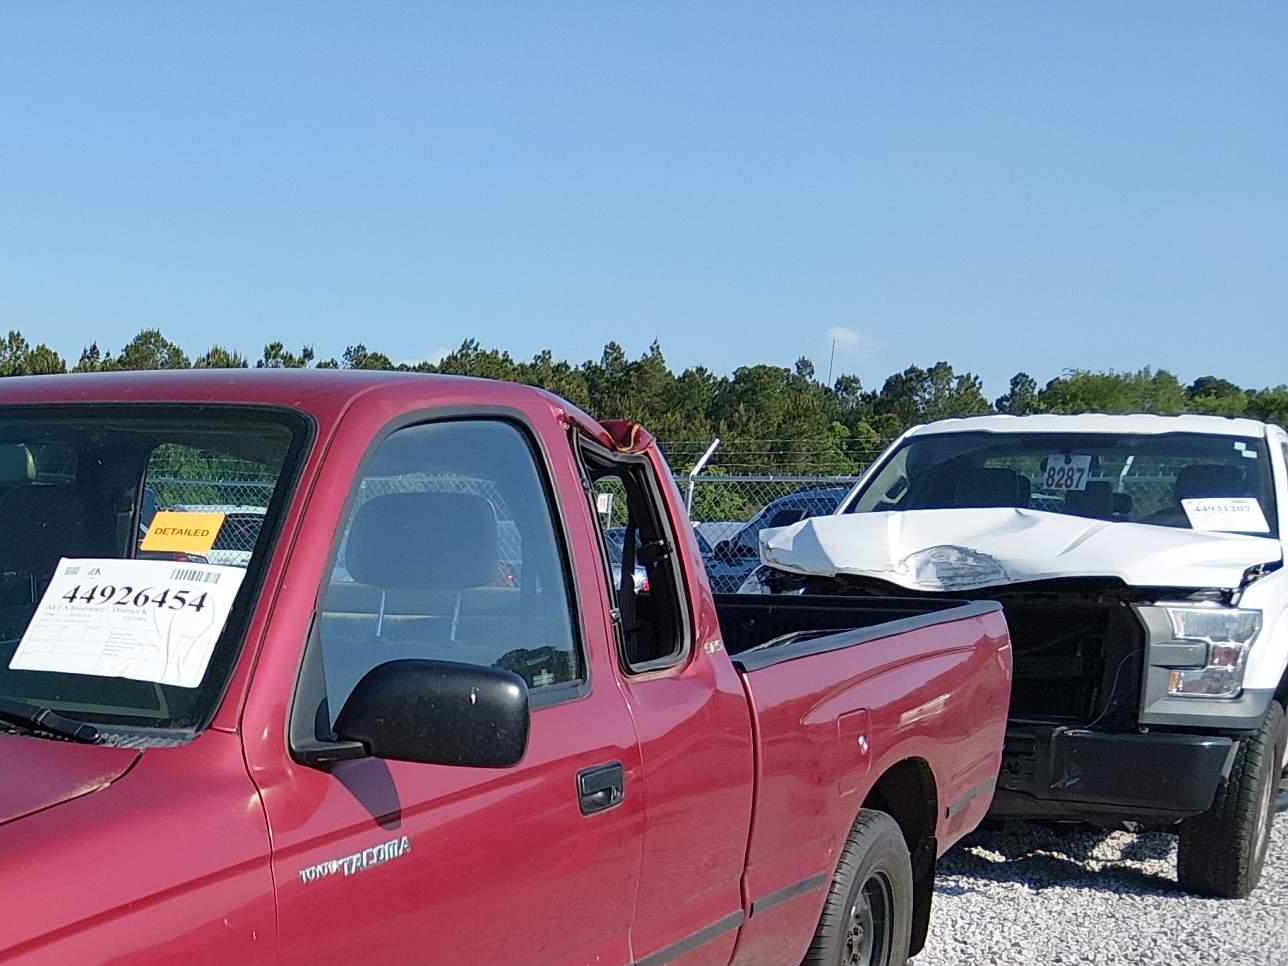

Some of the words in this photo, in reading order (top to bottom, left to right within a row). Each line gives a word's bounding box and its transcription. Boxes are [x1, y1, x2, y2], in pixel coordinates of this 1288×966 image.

[1046, 466, 1086, 489] 8287
[153, 527, 210, 537] DETAILED
[62, 584, 208, 612] 44926454
[342, 835, 412, 876] TACOMA
